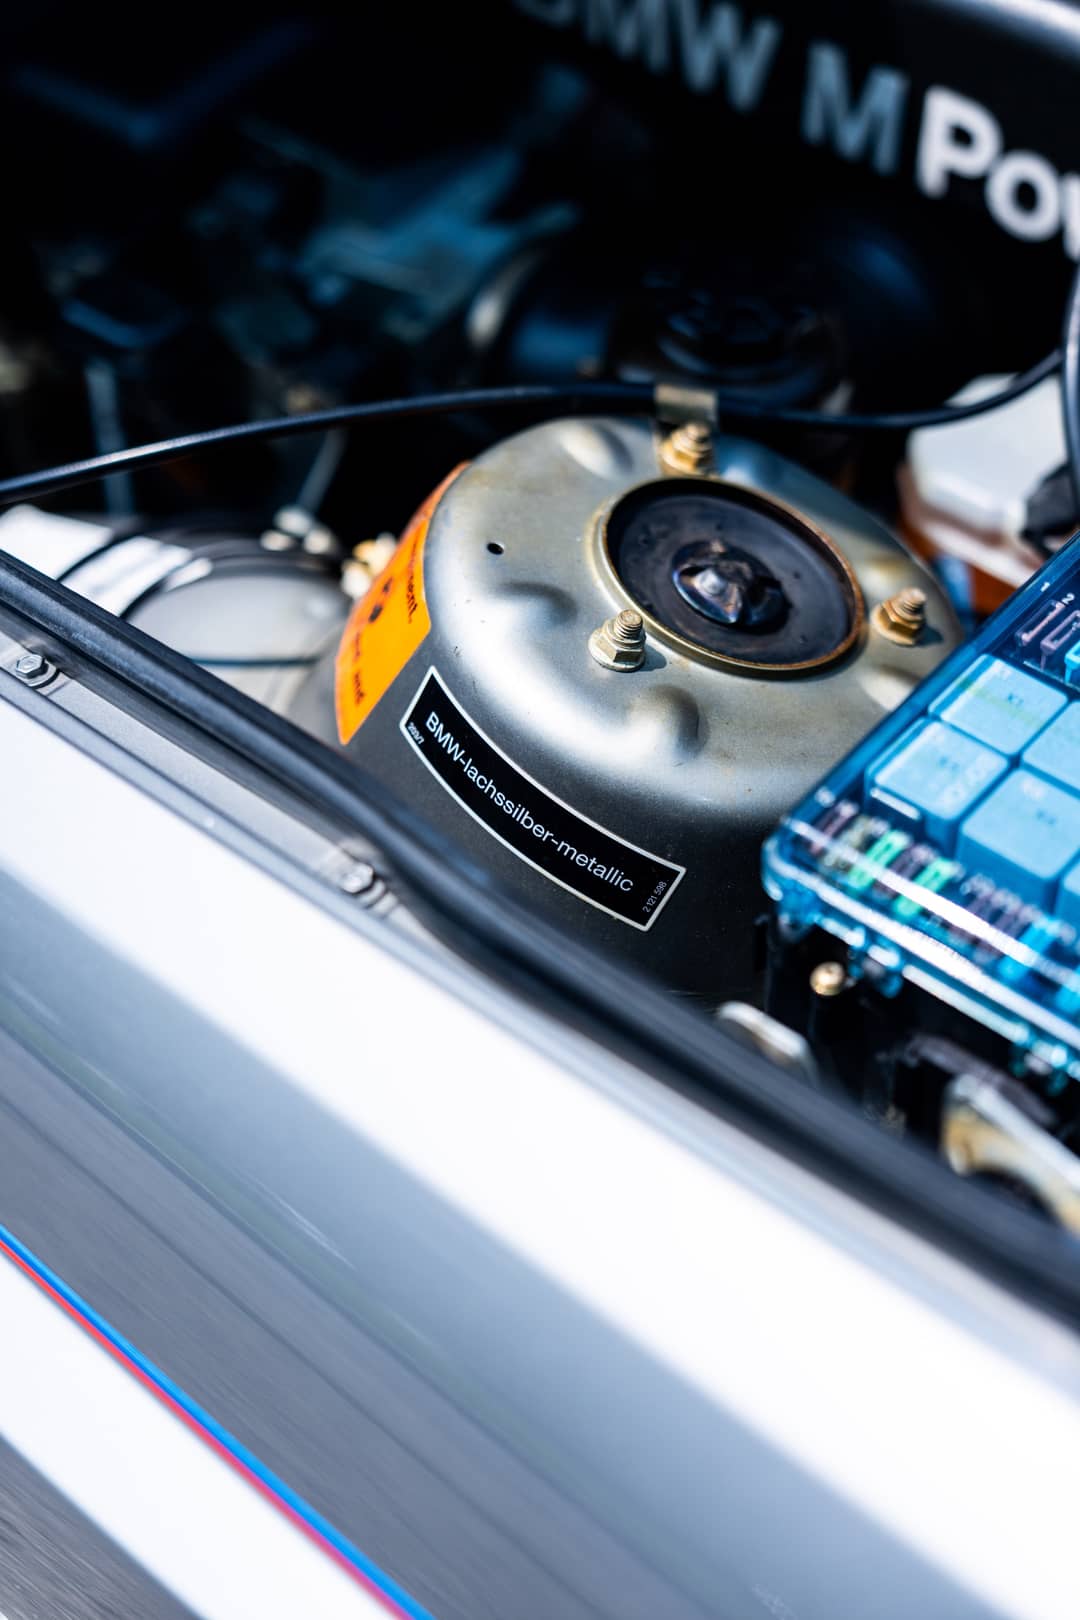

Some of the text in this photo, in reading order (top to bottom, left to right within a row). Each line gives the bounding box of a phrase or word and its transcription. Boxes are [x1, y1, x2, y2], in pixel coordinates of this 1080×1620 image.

[916, 85, 1080, 260] Po
[1061, 592, 1075, 605] 2
[426, 711, 634, 892] BMW-lachssilber-metallic
